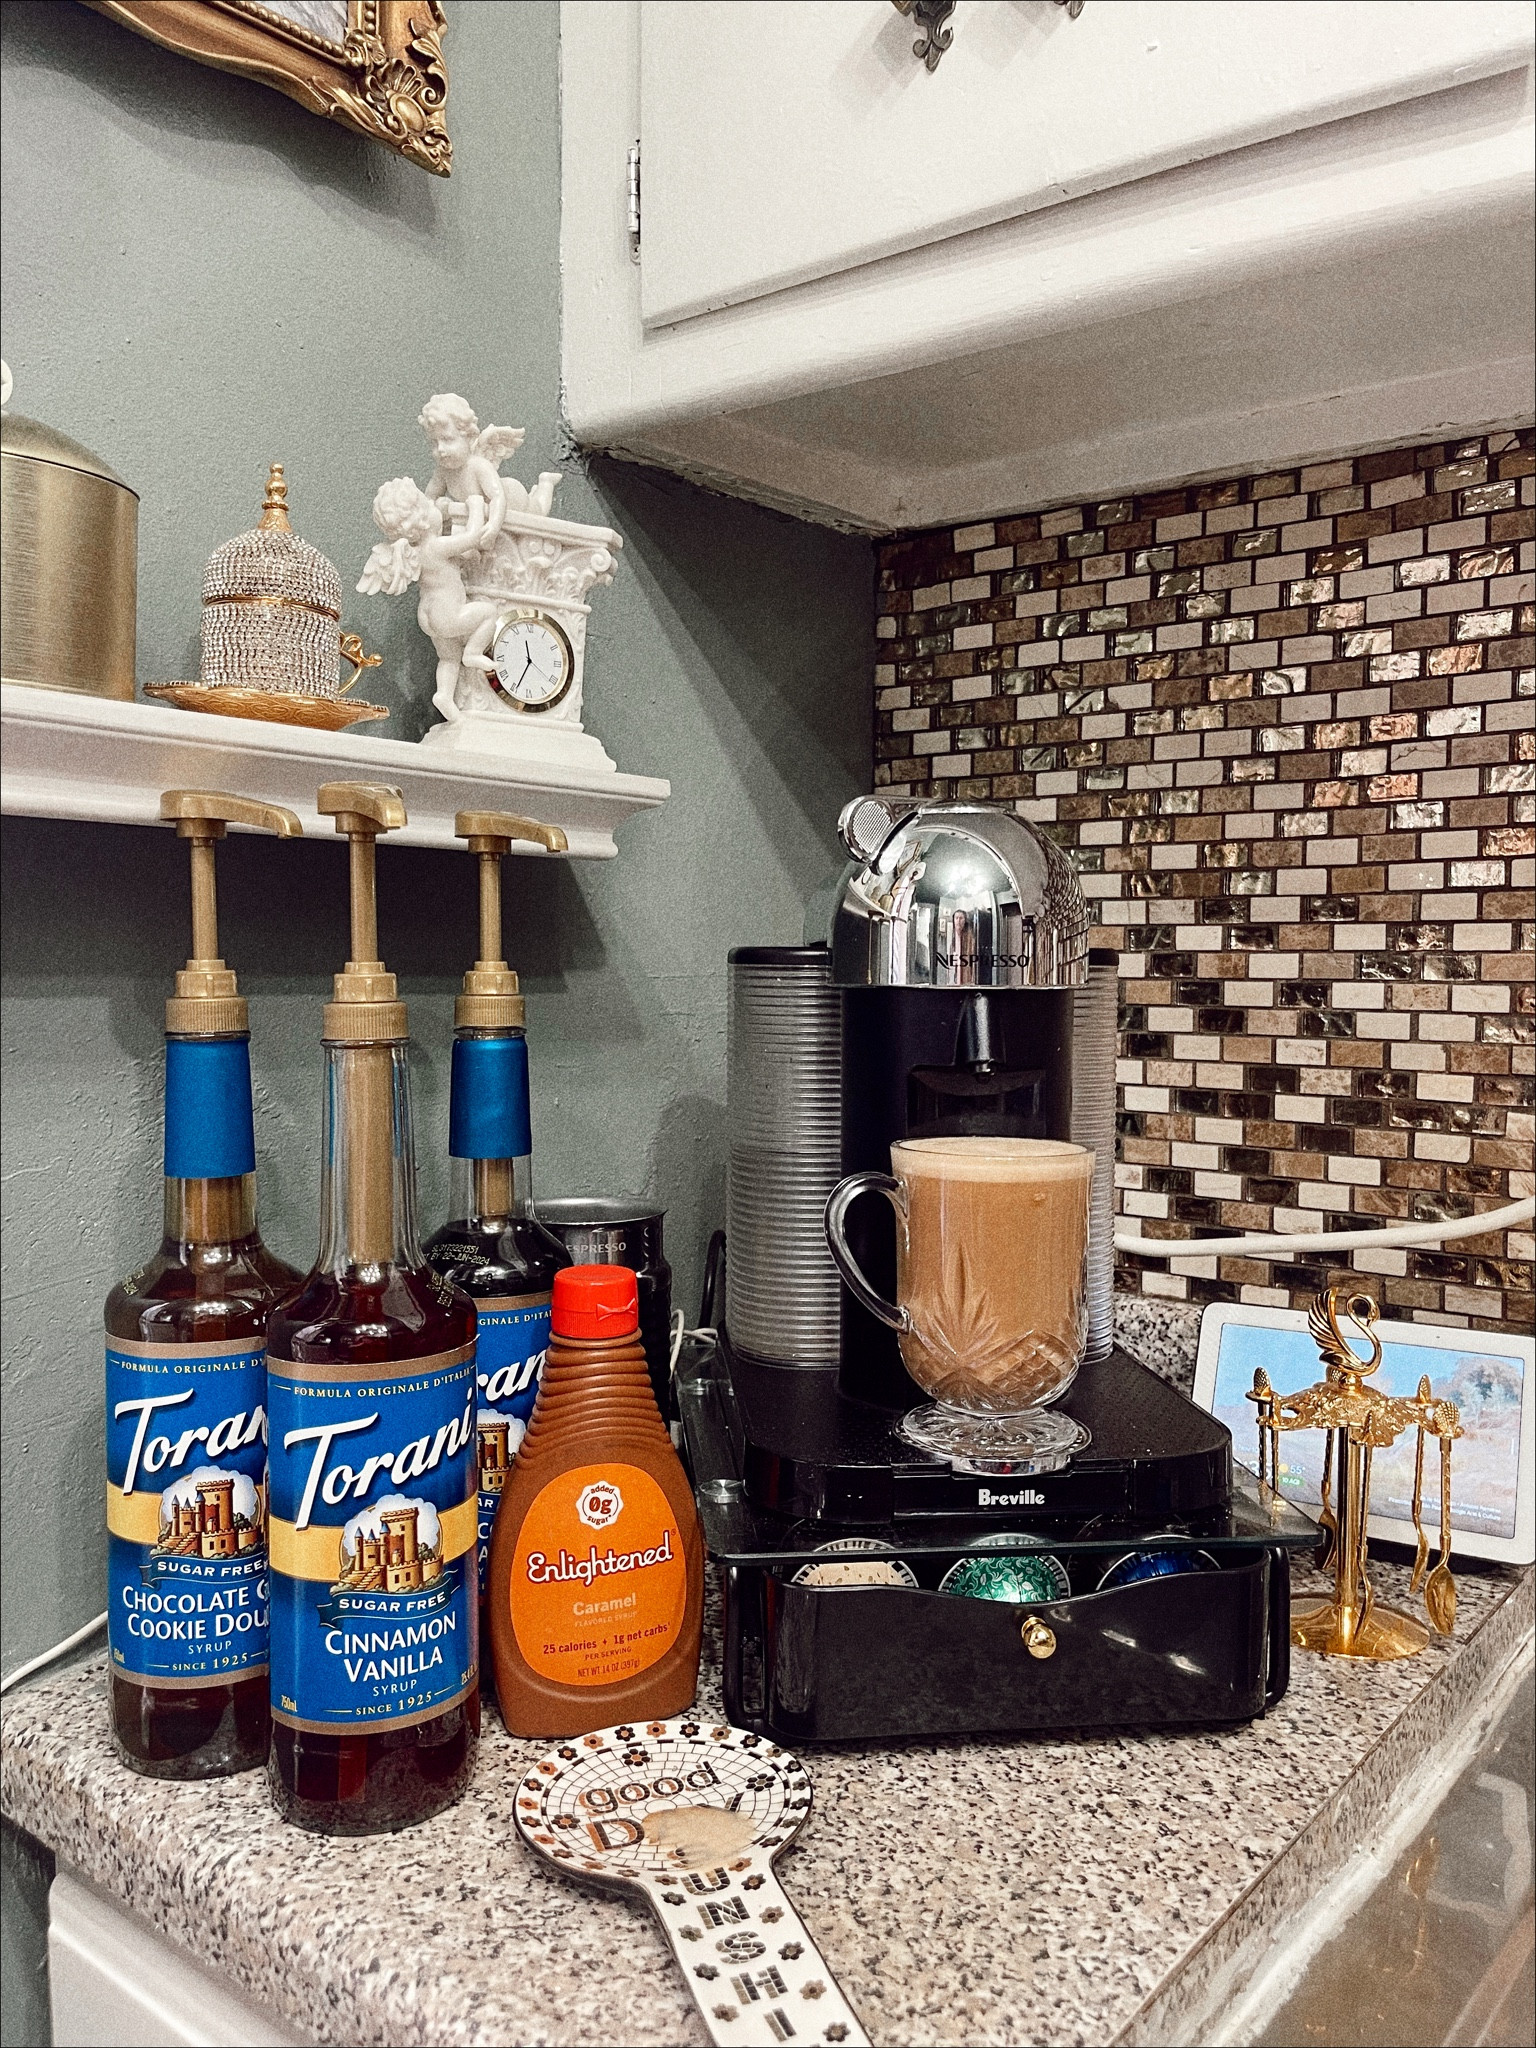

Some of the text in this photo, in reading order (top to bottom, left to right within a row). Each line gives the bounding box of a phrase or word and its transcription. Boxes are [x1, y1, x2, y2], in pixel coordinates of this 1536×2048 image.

[936, 951, 1030, 969] NESPESSO
[565, 1242, 627, 1253] ESPRESSO
[479, 1310, 552, 1326] GINALE D'ITA
[121, 1361, 169, 1374] FORMULA
[174, 1360, 246, 1374] ORIGINALE
[294, 1386, 351, 1398] FORMULA
[357, 1381, 429, 1397] ORIGINALE
[114, 1388, 269, 1496] Toran
[284, 1387, 474, 1531] Torani
[590, 1485, 615, 1494] added
[978, 1488, 1046, 1506] Breville
[589, 1496, 613, 1515] 0g
[527, 1529, 674, 1587] Enlightened
[157, 1559, 263, 1577] SUGAR FREE
[122, 1585, 250, 1614] CHOCOLATE
[339, 1591, 446, 1612] SUGAR FREE
[572, 1592, 637, 1616] Caramel
[127, 1608, 269, 1640] COOKIE DOU
[325, 1611, 456, 1655] CINNAMON
[188, 1640, 232, 1655] SYRUP
[543, 1644, 556, 1655] 25
[558, 1640, 597, 1653] calories
[614, 1634, 625, 1645] 1g
[627, 1630, 642, 1641] net
[172, 1652, 248, 1671] SINCE 1925
[585, 1646, 632, 1661] PER SERVING
[344, 1646, 443, 1683] VANILLA
[578, 1668, 590, 1678] NET
[602, 1664, 611, 1674] 14
[612, 1662, 620, 1672] OZ
[372, 1680, 418, 1697] SYRUP
[355, 1690, 433, 1716] SINCE 1925
[579, 1761, 722, 1816] good
[667, 1847, 797, 2042] UNSHI
